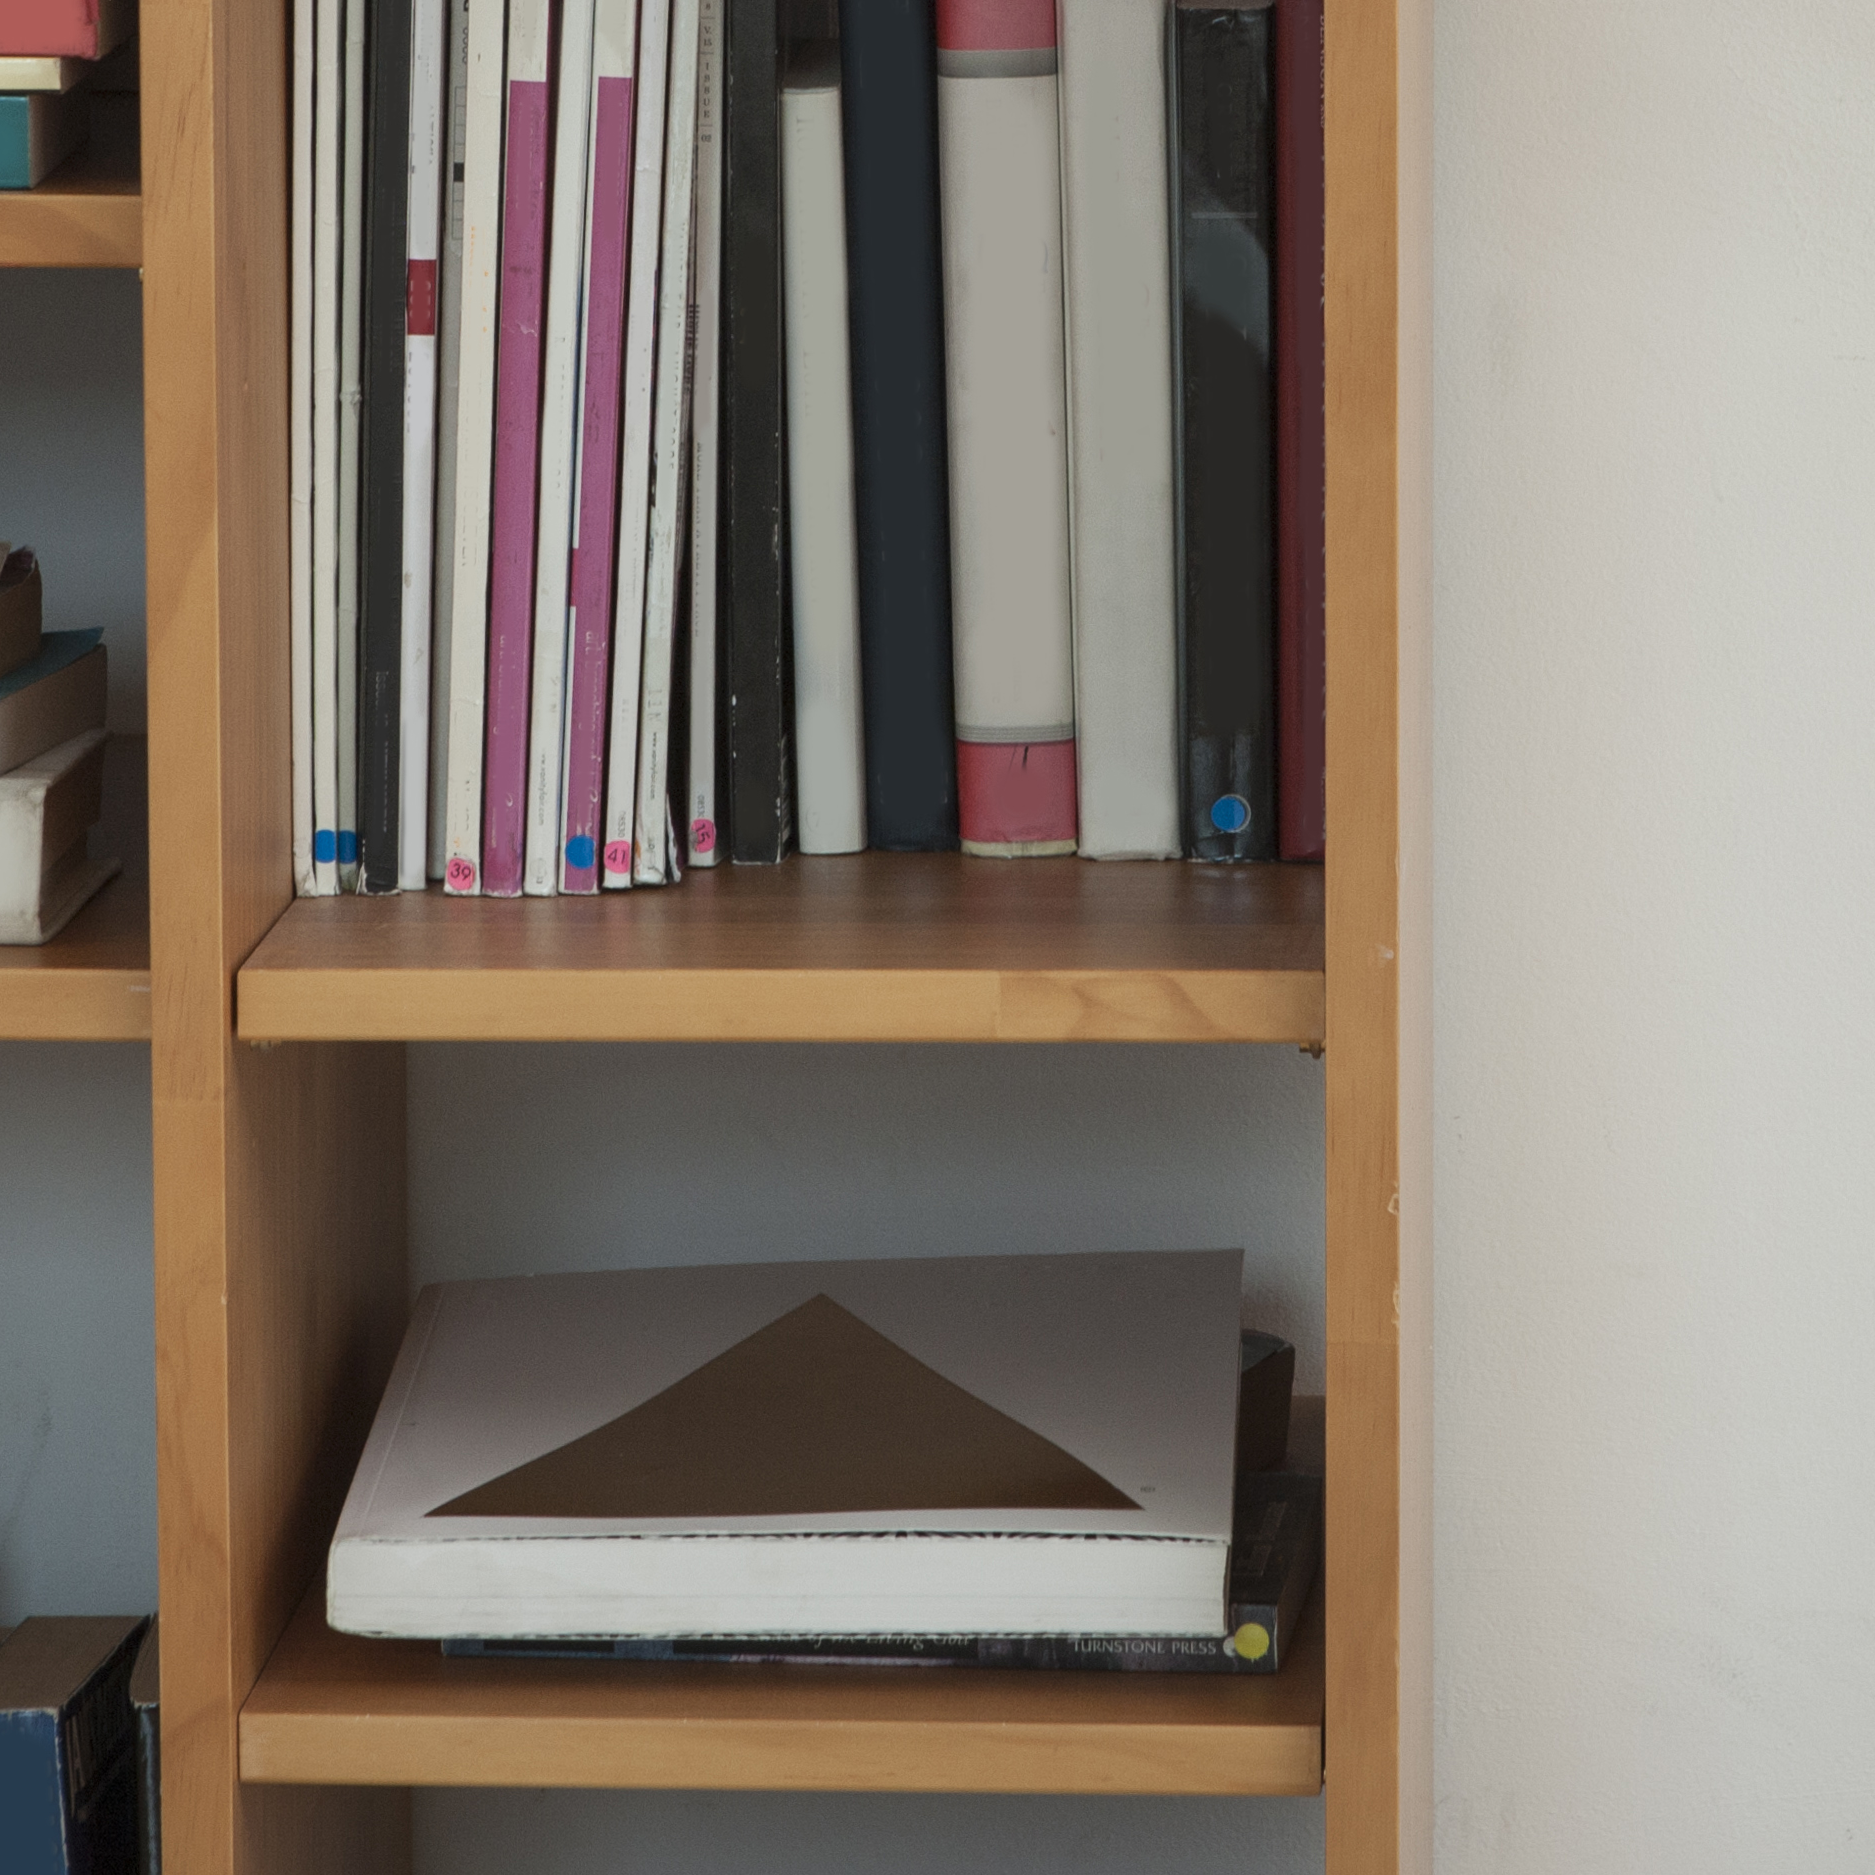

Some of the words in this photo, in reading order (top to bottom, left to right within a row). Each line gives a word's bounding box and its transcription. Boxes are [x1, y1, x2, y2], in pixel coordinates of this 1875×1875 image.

[606, 847, 627, 866] 41
[449, 861, 472, 882] 39
[1170, 1640, 1217, 1657] PRESS
